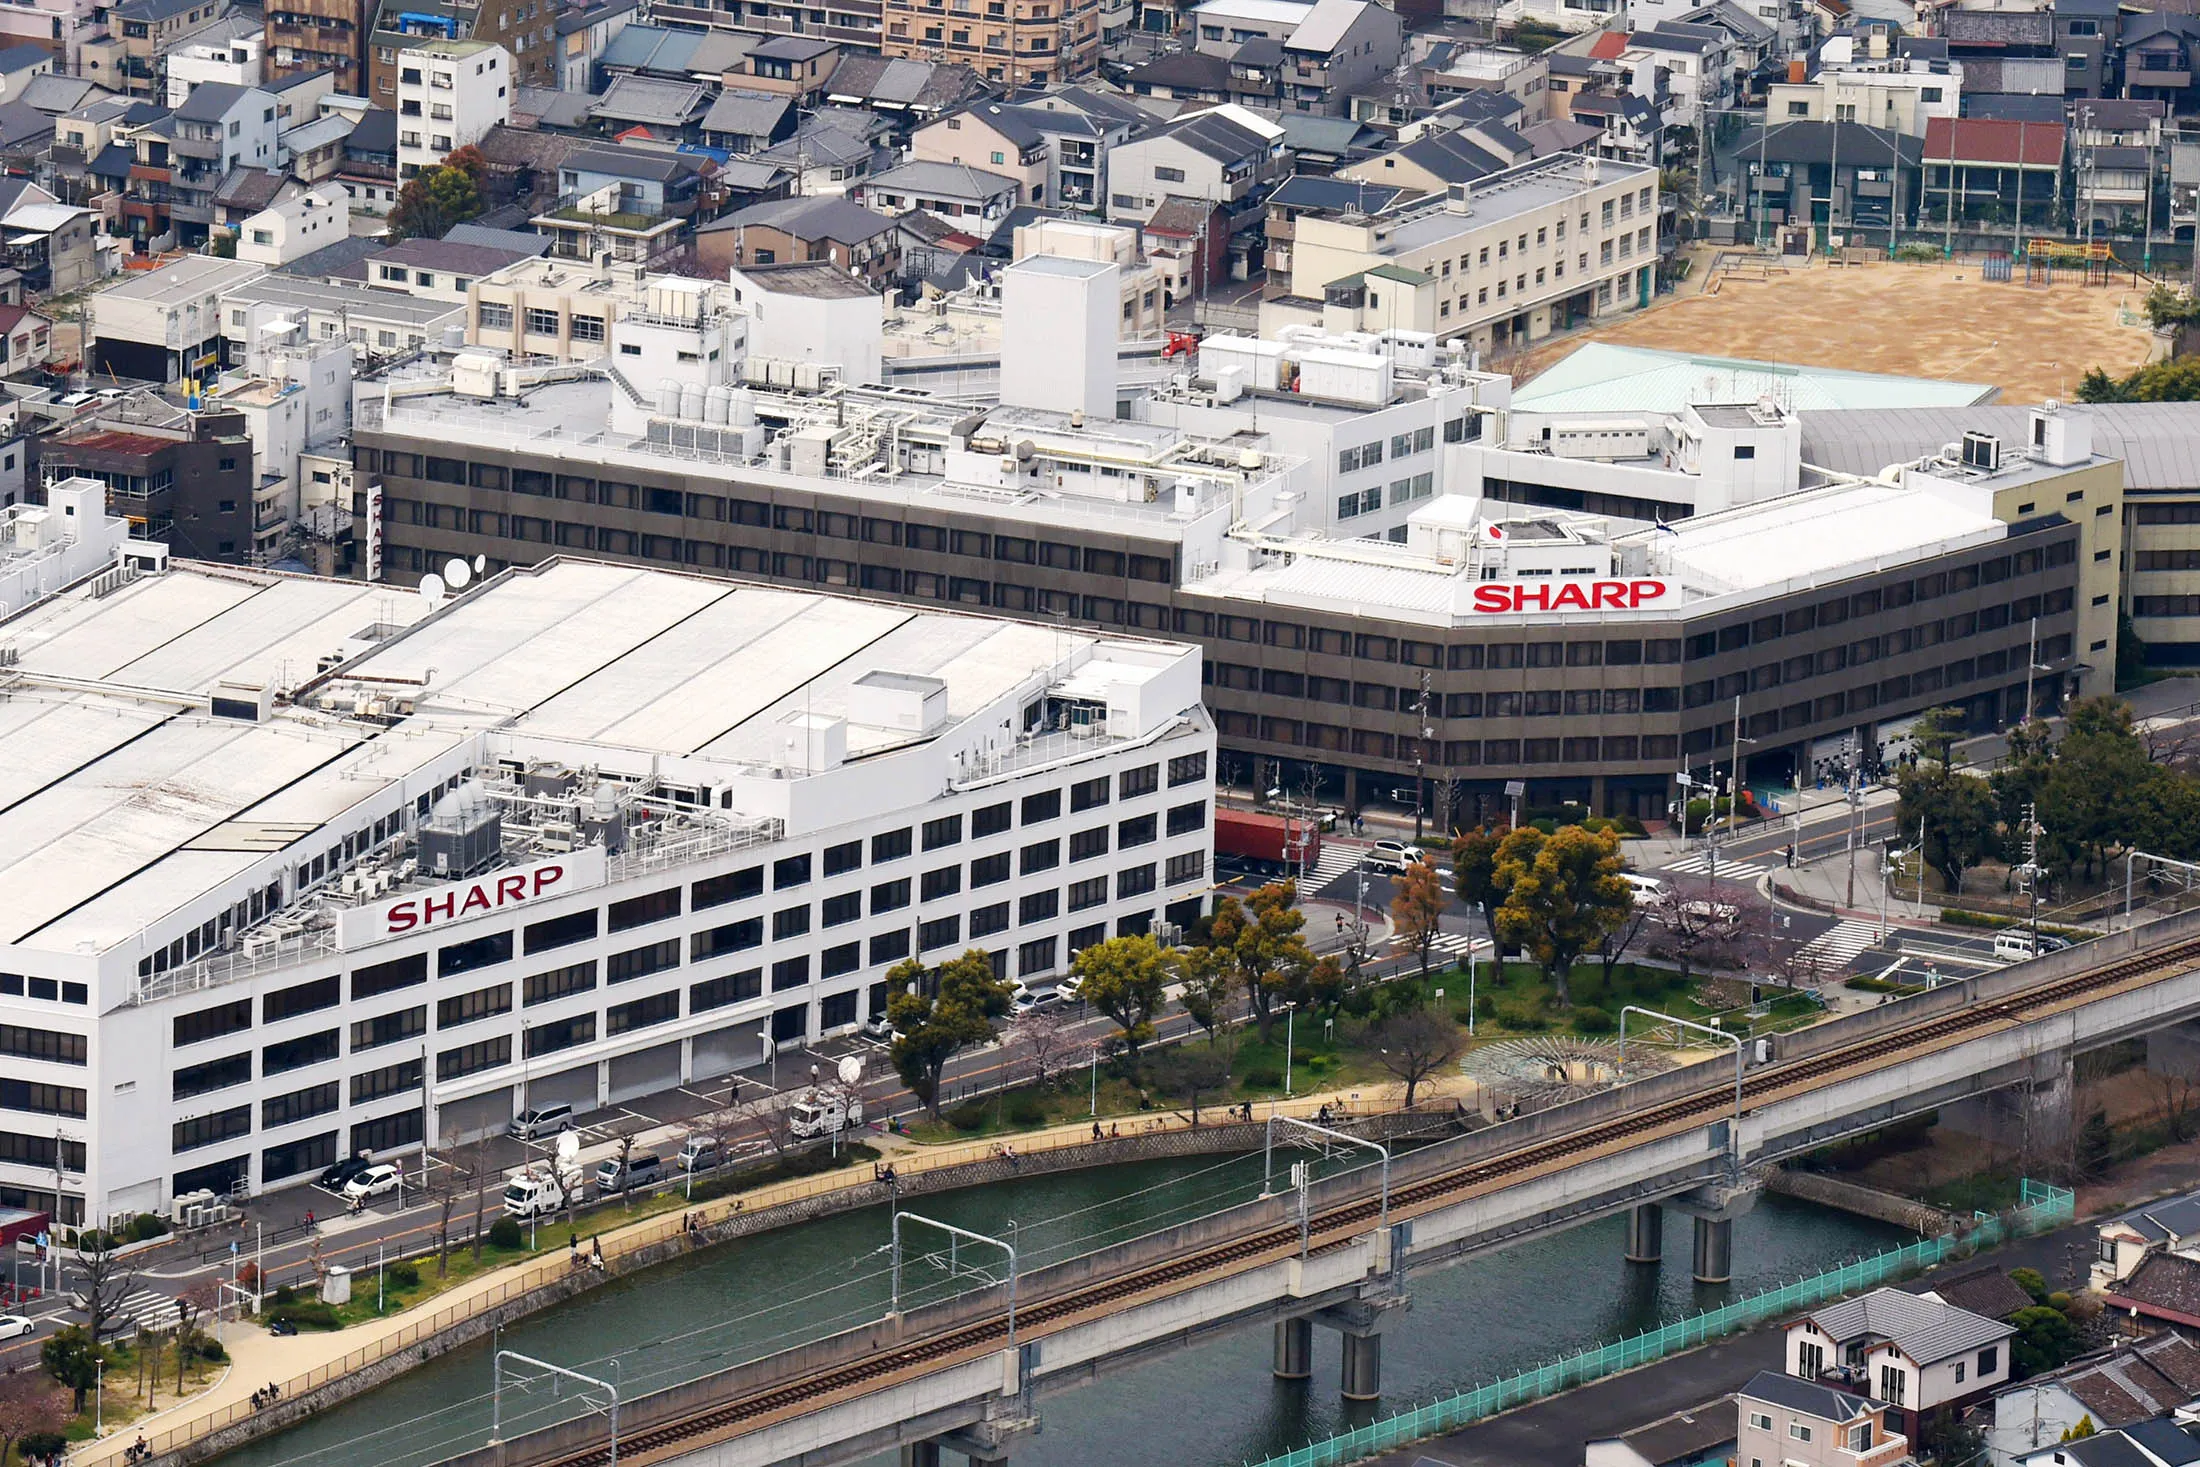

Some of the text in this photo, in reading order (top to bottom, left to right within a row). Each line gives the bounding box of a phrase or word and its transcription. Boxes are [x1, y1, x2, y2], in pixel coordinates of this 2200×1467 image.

[373, 494, 382, 574] SHARP
[1473, 580, 1666, 613] SHARP
[387, 865, 564, 933] SHARP
